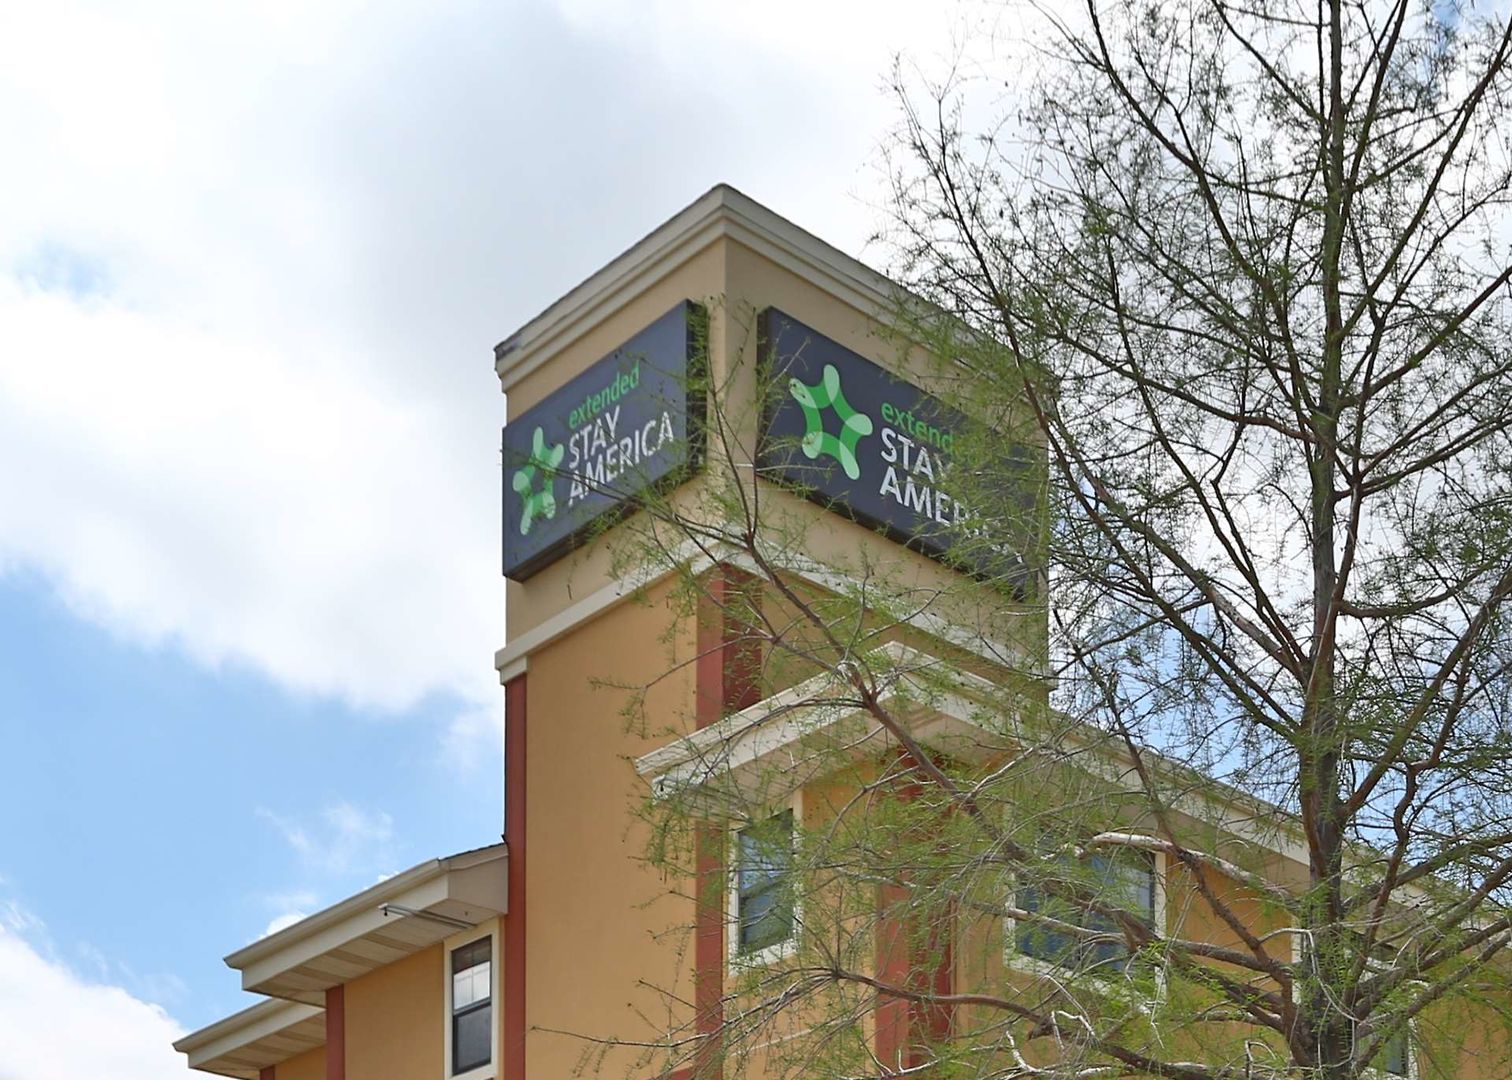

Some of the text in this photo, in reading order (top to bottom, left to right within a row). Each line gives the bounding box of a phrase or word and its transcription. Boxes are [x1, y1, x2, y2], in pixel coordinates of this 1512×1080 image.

[569, 361, 640, 429] extended
[568, 406, 620, 470] STAY
[568, 411, 675, 507] AMERICA
